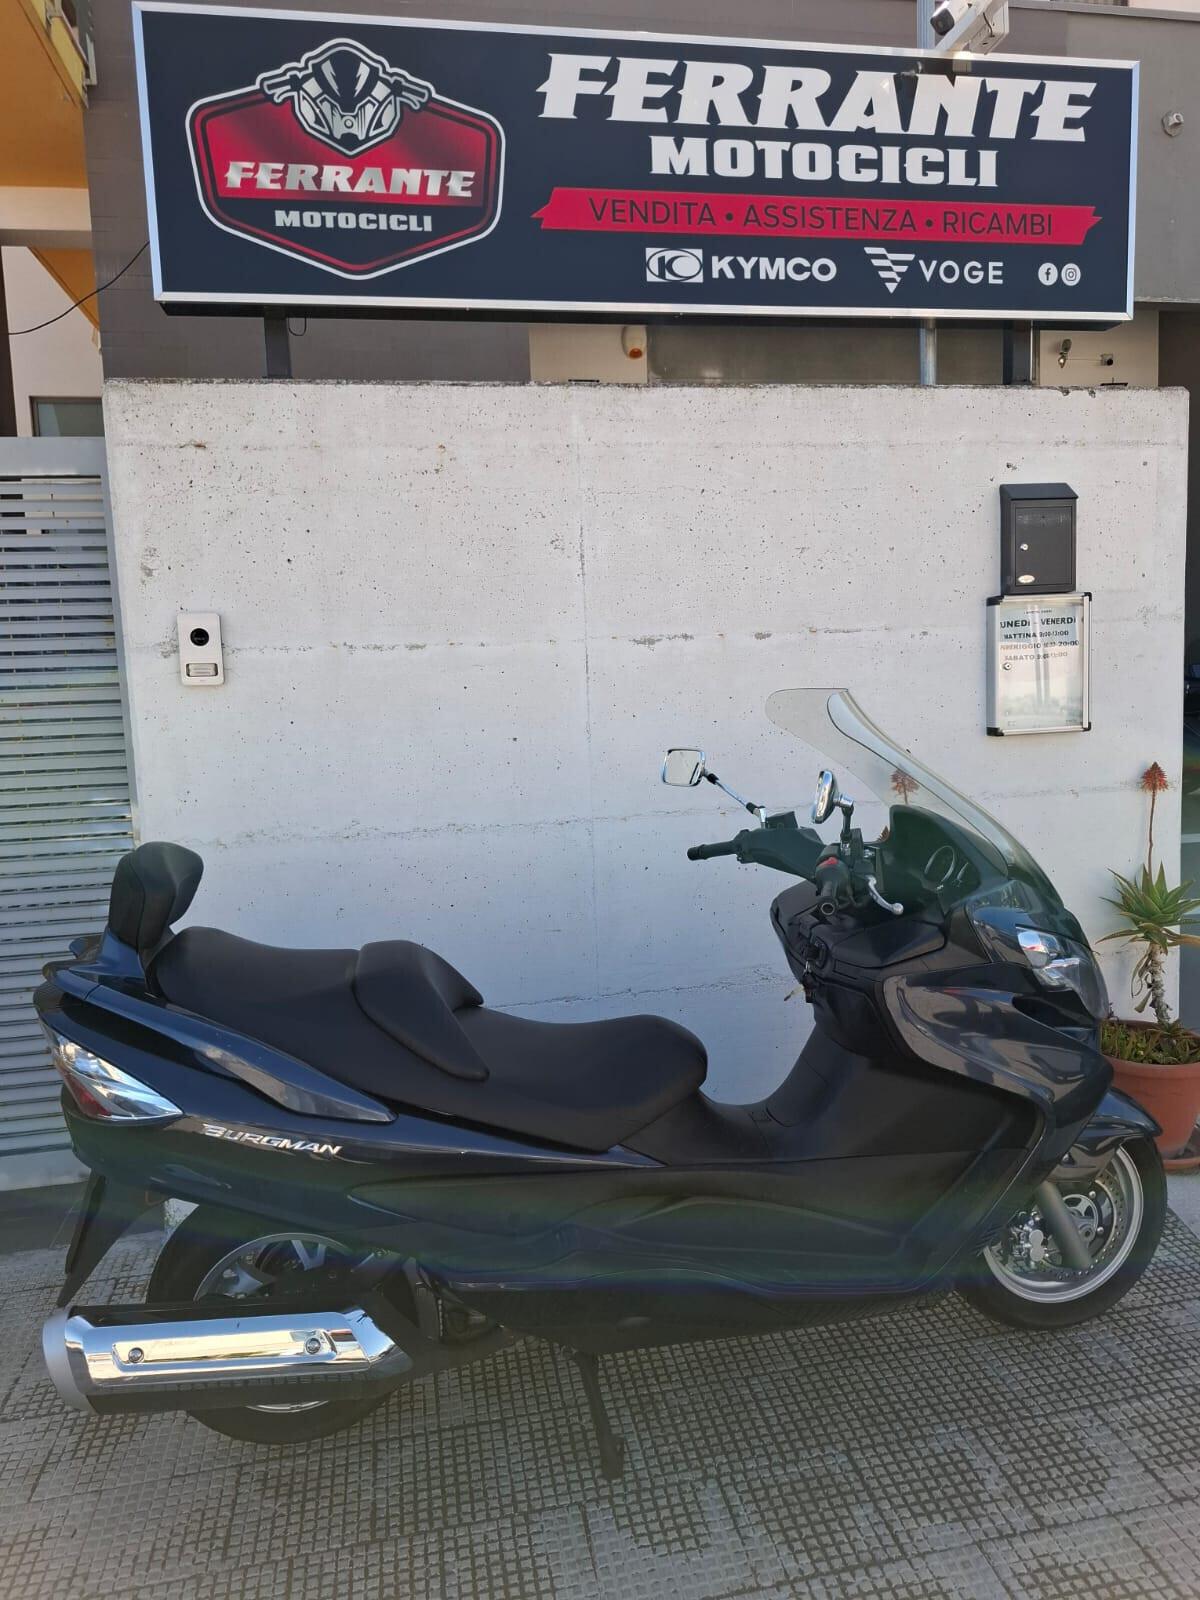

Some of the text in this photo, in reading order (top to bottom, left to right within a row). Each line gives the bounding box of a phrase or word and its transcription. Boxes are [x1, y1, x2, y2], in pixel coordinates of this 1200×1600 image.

[537, 53, 1097, 142] FERRANTE
[649, 136, 998, 187] MOTOCICLI
[225, 161, 476, 197] FERRANTE
[275, 210, 433, 232] MOTOCICLI
[589, 198, 1052, 236] VENDITA ASSISTENZA RICAMBI
[711, 256, 837, 282] KYMCO
[919, 260, 1004, 284] VOGE
[202, 1123, 343, 1155] BURGMAN
